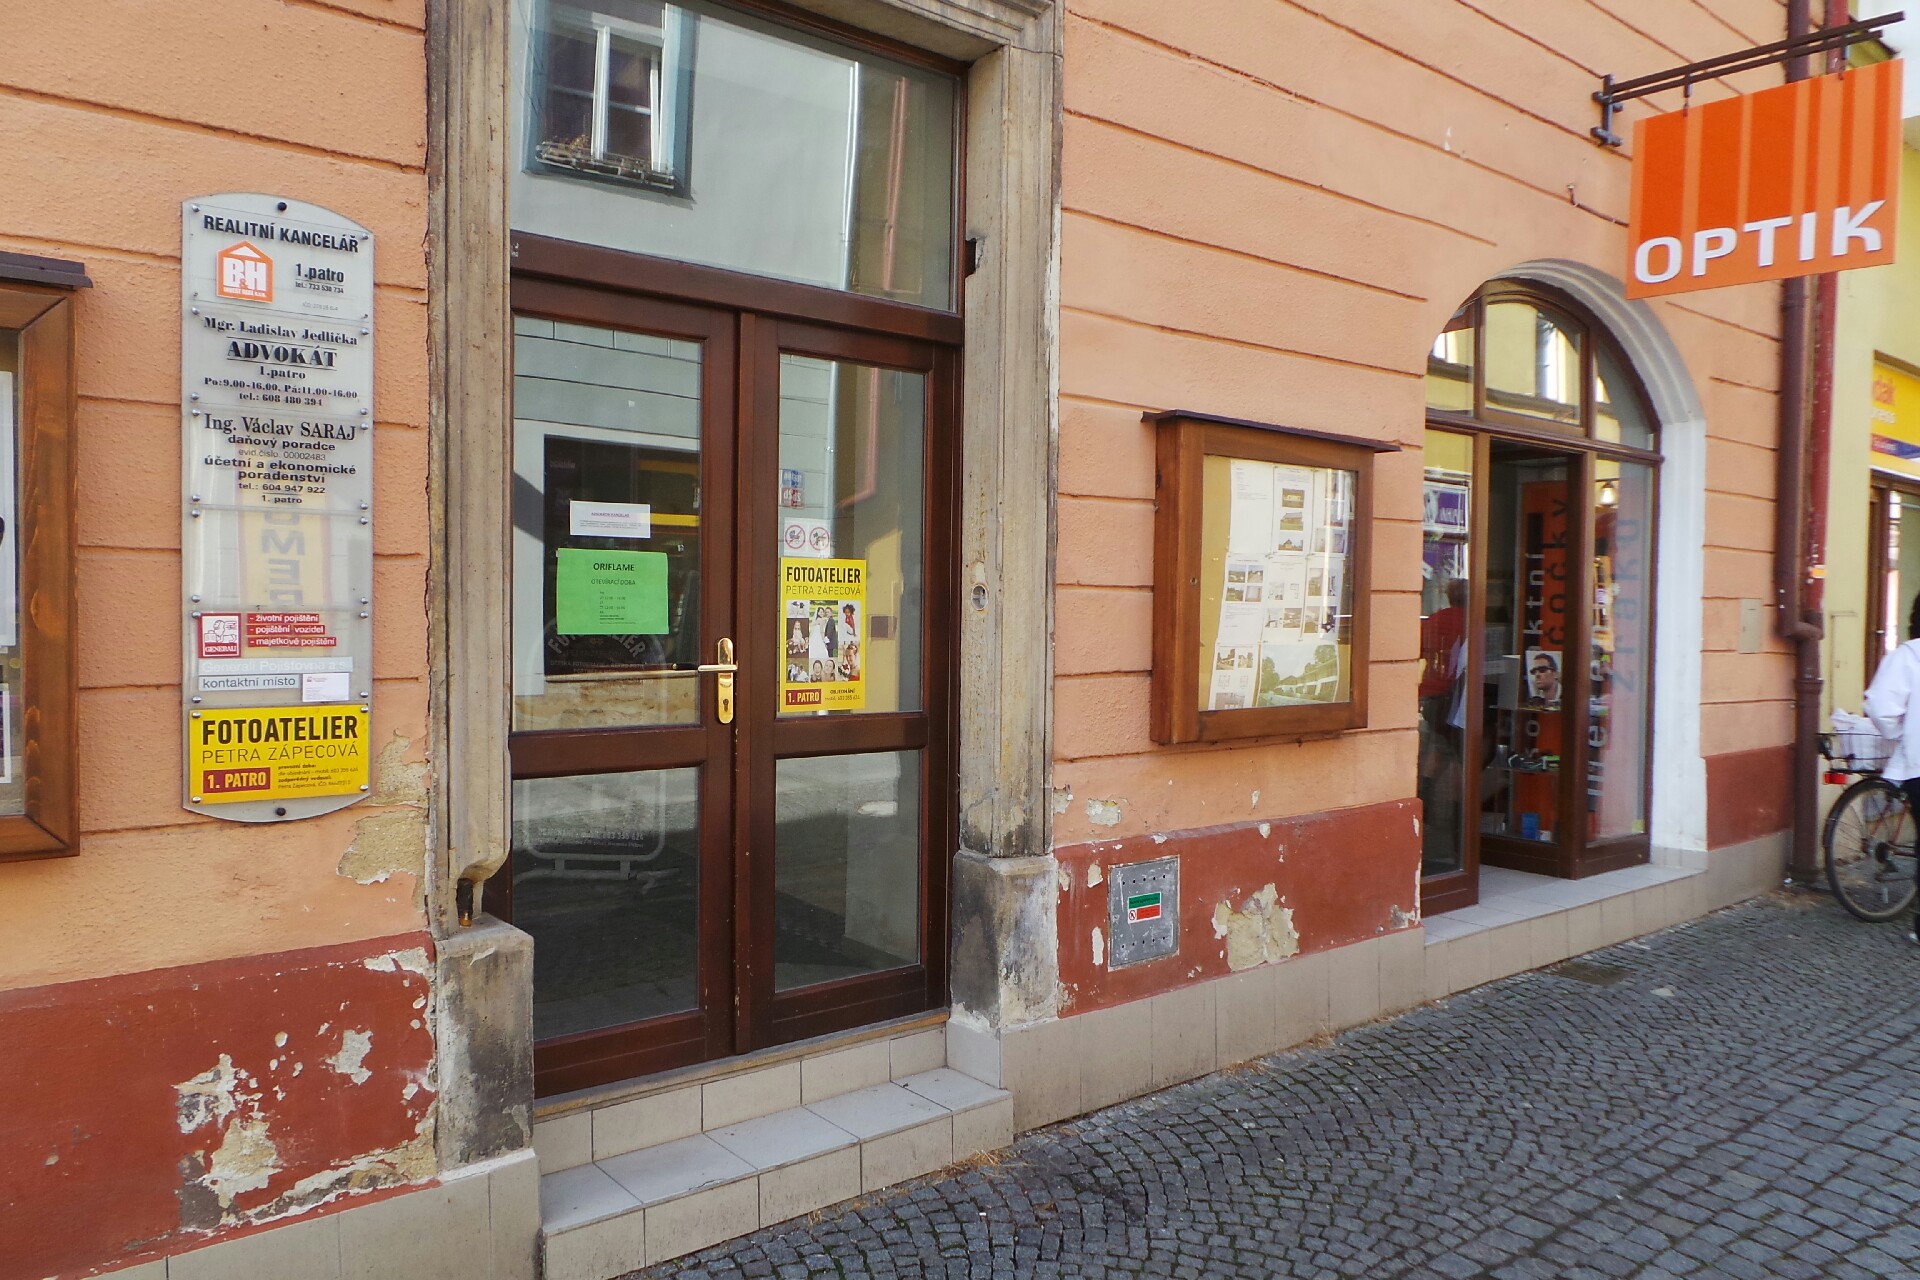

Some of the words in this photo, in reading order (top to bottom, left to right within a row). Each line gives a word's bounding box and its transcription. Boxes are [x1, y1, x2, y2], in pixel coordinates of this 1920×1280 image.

[204, 214, 275, 240] REALITNÍ
[280, 228, 359, 252] KANCELÁŘ
[1634, 199, 1887, 284] OPTIK
[296, 263, 344, 282] 1.patro
[204, 317, 235, 332] Mgr.
[240, 321, 297, 338] Ladislav
[302, 329, 358, 346] Jedlička
[227, 340, 337, 367] ADVOKÁT
[260, 366, 306, 380] 1.patro
[262, 393, 281, 402] 608
[204, 413, 237, 434] Ing.
[241, 416, 294, 436] Václav
[300, 421, 356, 441] SARAJ
[228, 434, 277, 449] daňový
[282, 439, 336, 451] poradce
[204, 455, 251, 468] účetní
[270, 460, 356, 474] ekonomické
[238, 470, 325, 483] poradenství
[307, 486, 325, 494] 922
[274, 495, 302, 504] patro
[593, 562, 635, 571] ORIFLAME
[786, 566, 861, 584] FOTOATELIER
[786, 584, 814, 595] PETRA
[818, 584, 861, 595] ZÁPECOVÁ
[256, 614, 282, 622] životní
[284, 614, 319, 623] pojištění
[256, 625, 290, 634] pojištění
[256, 637, 299, 646] majetkové
[300, 638, 335, 646] pojištění
[202, 660, 256, 672] Generali
[203, 677, 260, 688] kontaktní
[263, 677, 296, 687] místo
[788, 693, 795, 703] 1.
[797, 691, 820, 702] PATRO
[202, 715, 358, 745] FOTOATELIER
[203, 748, 261, 764] PETRA
[268, 741, 359, 760] ZÁPECOVÁ
[208, 774, 220, 789] 1.
[225, 772, 266, 788] PATRO
